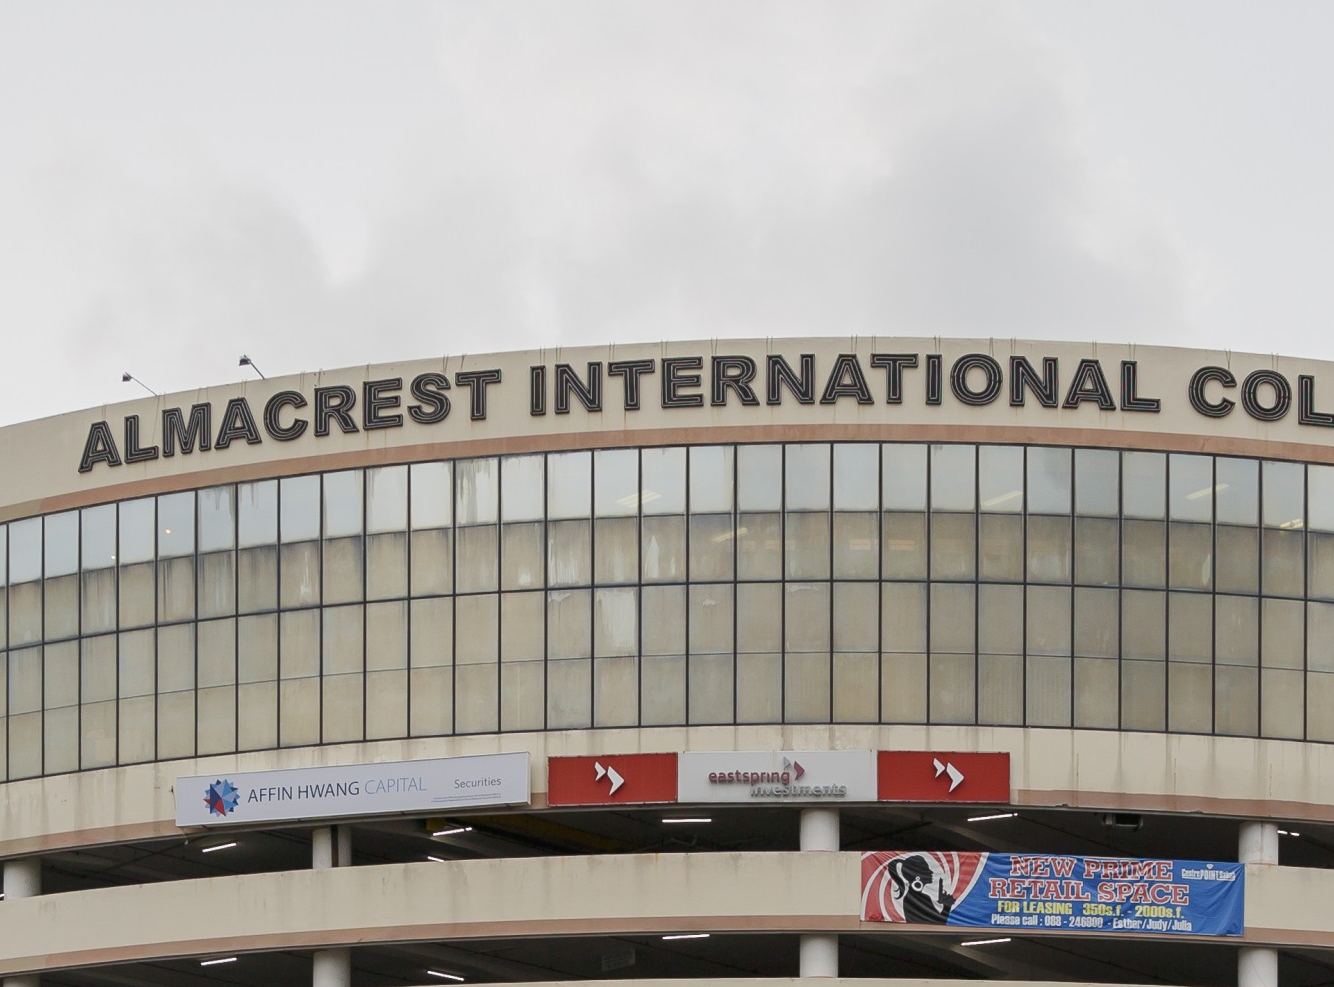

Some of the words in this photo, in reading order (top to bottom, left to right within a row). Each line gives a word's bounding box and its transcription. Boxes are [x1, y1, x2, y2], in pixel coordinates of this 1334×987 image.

[78, 368, 502, 473] ALMACREST
[529, 352, 1162, 417] INTERNATIONAL
[453, 776, 502, 790] Securities
[708, 768, 791, 785] eastspring
[247, 785, 294, 804] AFFIN
[297, 780, 360, 800] HWANG
[364, 776, 427, 796] CAPITAL
[750, 782, 847, 799] investments
[1010, 855, 1077, 878] NEW
[1083, 858, 1174, 882] PRIME
[988, 877, 1091, 902] RETAIL
[1097, 881, 1190, 906] SPACE
[997, 901, 1020, 914] FOR
[1023, 901, 1073, 915] LEASING
[991, 913, 1020, 926] Please
[1021, 914, 1038, 926] call
